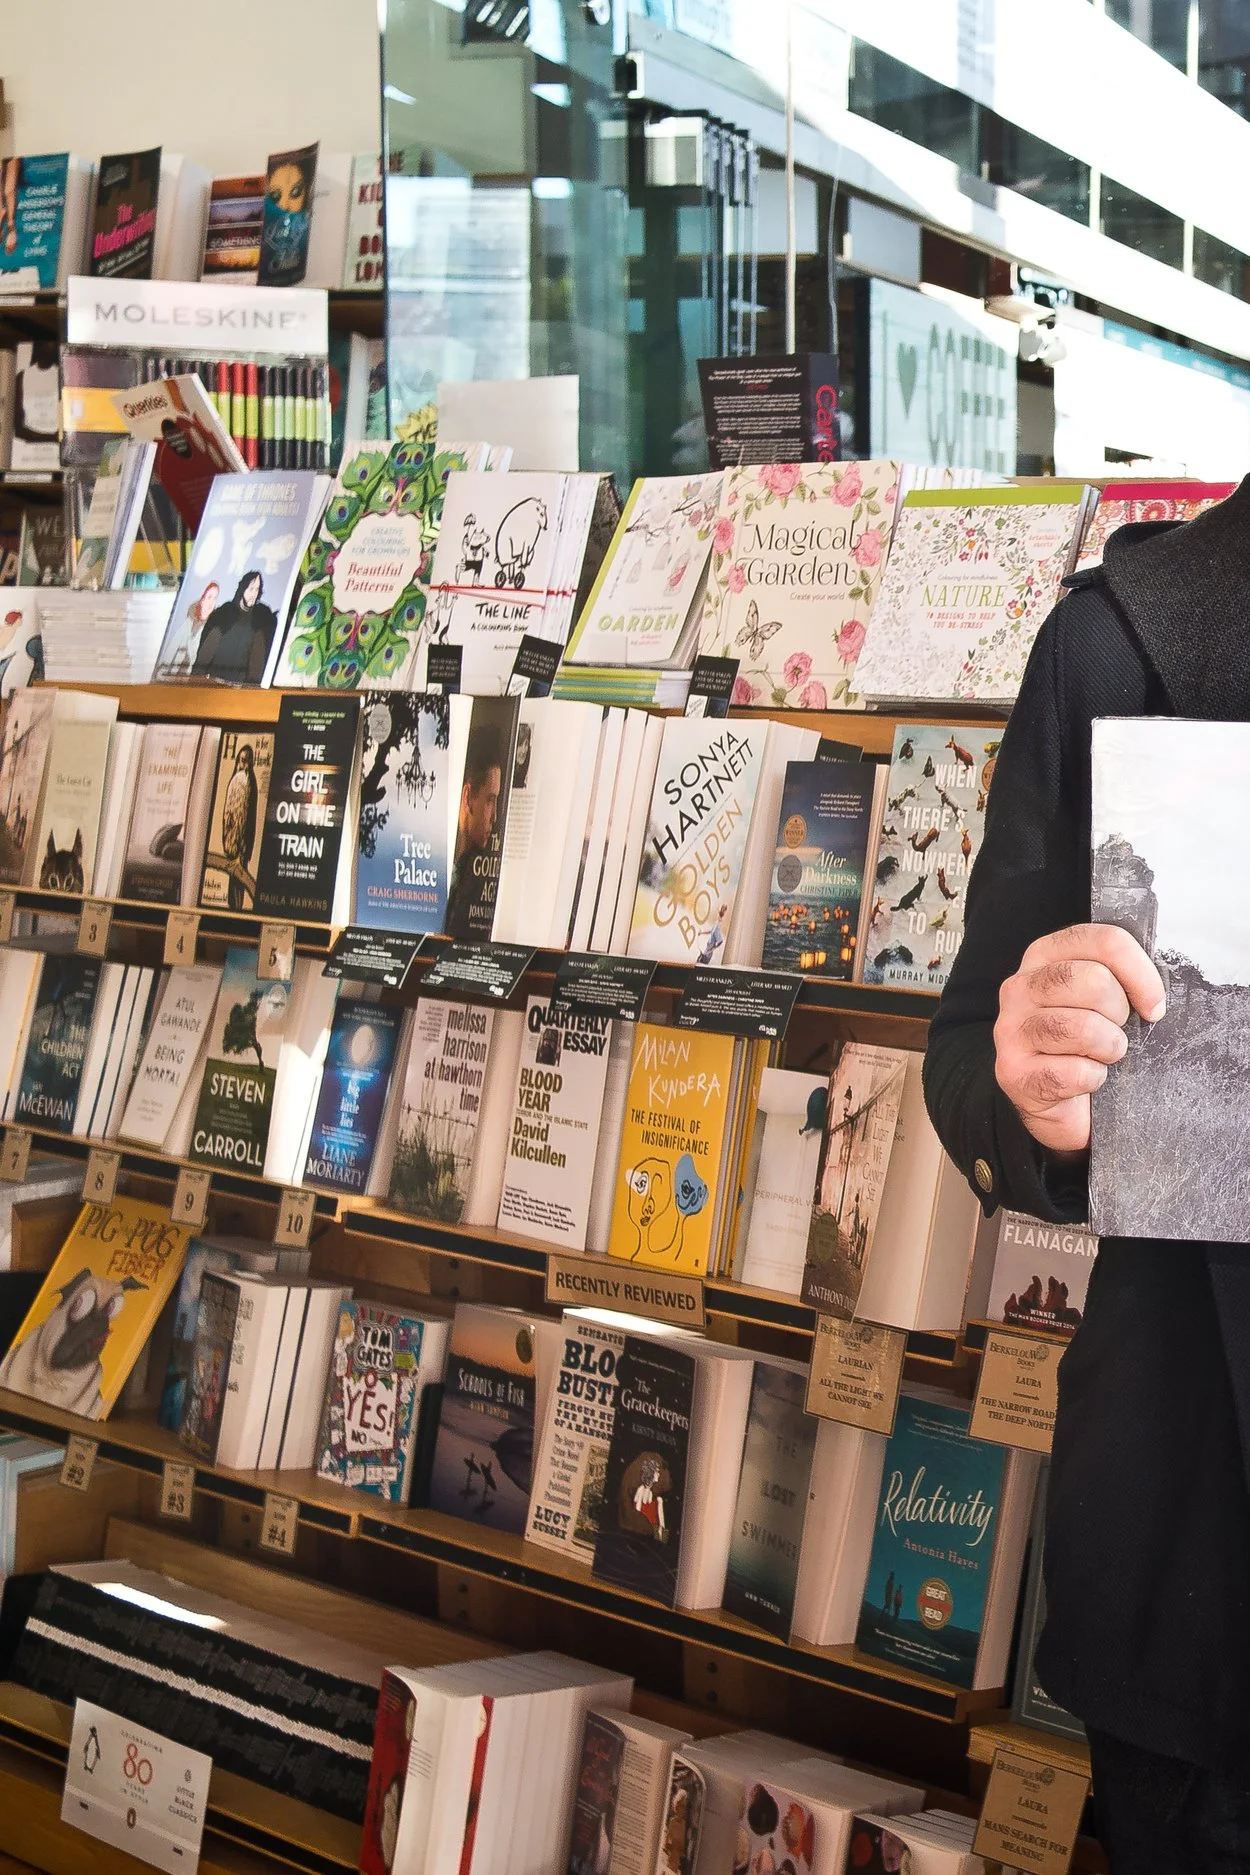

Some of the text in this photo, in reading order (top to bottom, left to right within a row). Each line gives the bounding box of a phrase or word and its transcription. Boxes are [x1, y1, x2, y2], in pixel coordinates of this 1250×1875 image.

[258, 482, 298, 501] THRONES
[742, 520, 862, 556] Magical
[347, 561, 404, 577] Beautiful
[344, 578, 395, 592] Patterns
[920, 584, 1009, 608] NATURE
[789, 592, 829, 602] Create your
[475, 603, 533, 620] THE LINE
[599, 613, 678, 633] GARDEN
[302, 744, 327, 762] THE
[149, 763, 189, 779] EXAMINED
[664, 731, 739, 806] SONYA
[935, 763, 978, 789] WHEN
[157, 782, 174, 795] LIFE
[291, 770, 330, 794] GIRL
[651, 738, 754, 865] HARTNETT
[276, 801, 336, 827] ON THE
[903, 806, 965, 832] THERE'S
[278, 833, 324, 859] TRAIN
[400, 833, 432, 859] Tree
[652, 798, 743, 928] GOLDEN
[817, 850, 847, 870] After
[394, 858, 438, 888] Palace
[805, 866, 858, 886] Darkness
[260, 892, 328, 911] PAULA HAWKINS
[367, 887, 439, 904] CRAIG SHERBORNE
[678, 856, 731, 949] BOYS
[908, 911, 927, 936] TO
[176, 934, 185, 954] 4
[268, 949, 278, 968] 5
[889, 968, 924, 983] MURRAY
[175, 997, 196, 1013] ATUL
[160, 1013, 202, 1034] GAWANDE
[448, 1005, 487, 1035] melissa
[527, 1005, 611, 1035] QUARTERLY
[70, 1024, 88, 1042] THE
[563, 1031, 609, 1057] ESSAY
[41, 1039, 84, 1060] CHILDREN
[154, 1044, 186, 1064] BEING
[442, 1031, 488, 1064] harrison
[62, 1063, 81, 1079] ACT
[143, 1065, 181, 1088] MORTAL
[424, 1057, 483, 1089] at hawthorn
[520, 1068, 563, 1094] BLOOD
[209, 1072, 267, 1105] STEVEN
[19, 1091, 75, 1122] McEWAN
[459, 1088, 480, 1113] time
[518, 1089, 552, 1113] YEAR
[513, 1117, 549, 1142] David
[533, 1112, 588, 1131] AND ISLAMIC STATE
[631, 1108, 702, 1134] THE FESTIVAL OF
[194, 1129, 263, 1168] CARROLL
[641, 1129, 710, 1156] INSIGNIFICANCE
[322, 1143, 358, 1167] LIANE
[510, 1141, 567, 1168] Kilcullen
[95, 1172, 104, 1190] 8
[306, 1157, 365, 1187] MORIARTY
[184, 1194, 194, 1211] 9
[754, 1189, 802, 1206] PERIPHERAL
[79, 1205, 125, 1244] PIG
[287, 1215, 304, 1234] 10
[1004, 1224, 1100, 1257] FLANAGAN
[555, 1271, 696, 1312] RECENTLY REVIEWED
[808, 1284, 843, 1306] ANTHONY
[1029, 1316, 1048, 1325] BOOKER
[1049, 1319, 1062, 1328] PRIZE
[1030, 1309, 1057, 1319] WINNER
[362, 1325, 394, 1349] TOM
[357, 1350, 394, 1371] GATES
[990, 1342, 1038, 1360] BERKELOUW
[837, 1354, 875, 1371] LAURIAN
[635, 1377, 651, 1395] The
[819, 1378, 848, 1392] ALL THE
[1016, 1376, 1042, 1388] LAURA
[558, 1399, 596, 1417] FERGUS
[621, 1389, 689, 1431] Gracekeepers
[828, 1392, 872, 1410] CANNOT SEE
[980, 1397, 1055, 1420] THE NARROW ROAD
[346, 1389, 395, 1436] YES!
[556, 1409, 578, 1423] THE
[988, 1411, 1004, 1420] THE
[1005, 1415, 1027, 1426] DEEP
[351, 1430, 367, 1445] NO
[777, 1436, 797, 1460] THE
[761, 1478, 796, 1507] LOST
[534, 1505, 572, 1529] LUCY
[880, 1466, 994, 1547] Relativity
[267, 1526, 288, 1549] #4
[532, 1521, 569, 1541] SUSSEX
[742, 1520, 800, 1559] SWIMMER
[903, 1537, 980, 1571] Antonia Hayes
[925, 1585, 948, 1600] GREAT
[924, 1606, 943, 1622] READ
[123, 1743, 153, 1786] 80
[168, 1804, 198, 1824] CLASSICS
[174, 1796, 194, 1810] BLACK
[1017, 1796, 1048, 1815] LAURA
[1000, 1840, 1044, 1862] MEANING
[1011, 1827, 1069, 1856] SEARCH FOR
